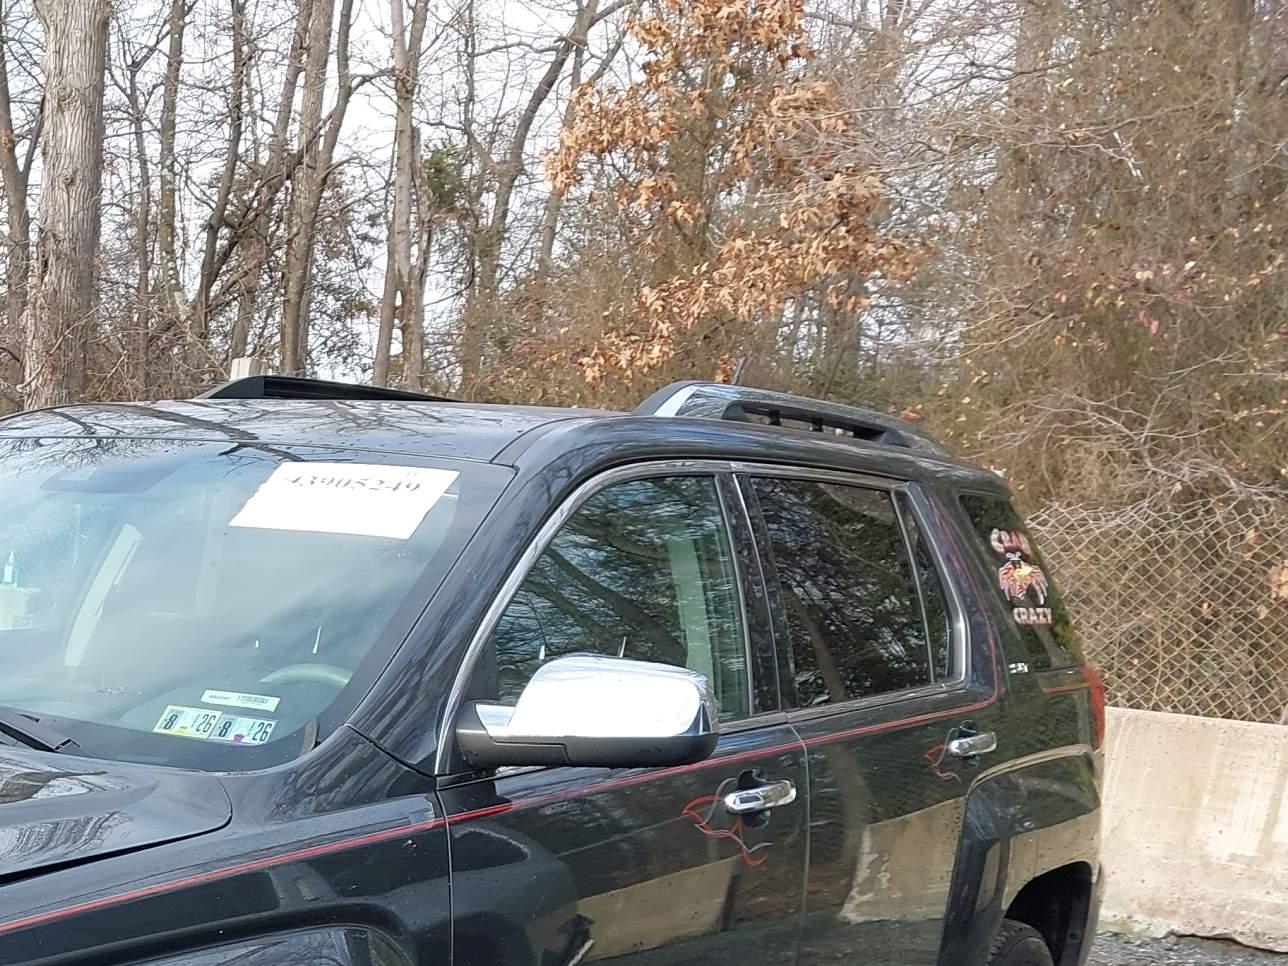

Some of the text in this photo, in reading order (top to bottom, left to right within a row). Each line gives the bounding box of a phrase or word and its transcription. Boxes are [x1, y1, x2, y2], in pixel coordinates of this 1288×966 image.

[1013, 607, 1052, 625] CRAZY
[196, 713, 216, 733] 26
[252, 722, 272, 742] 26
